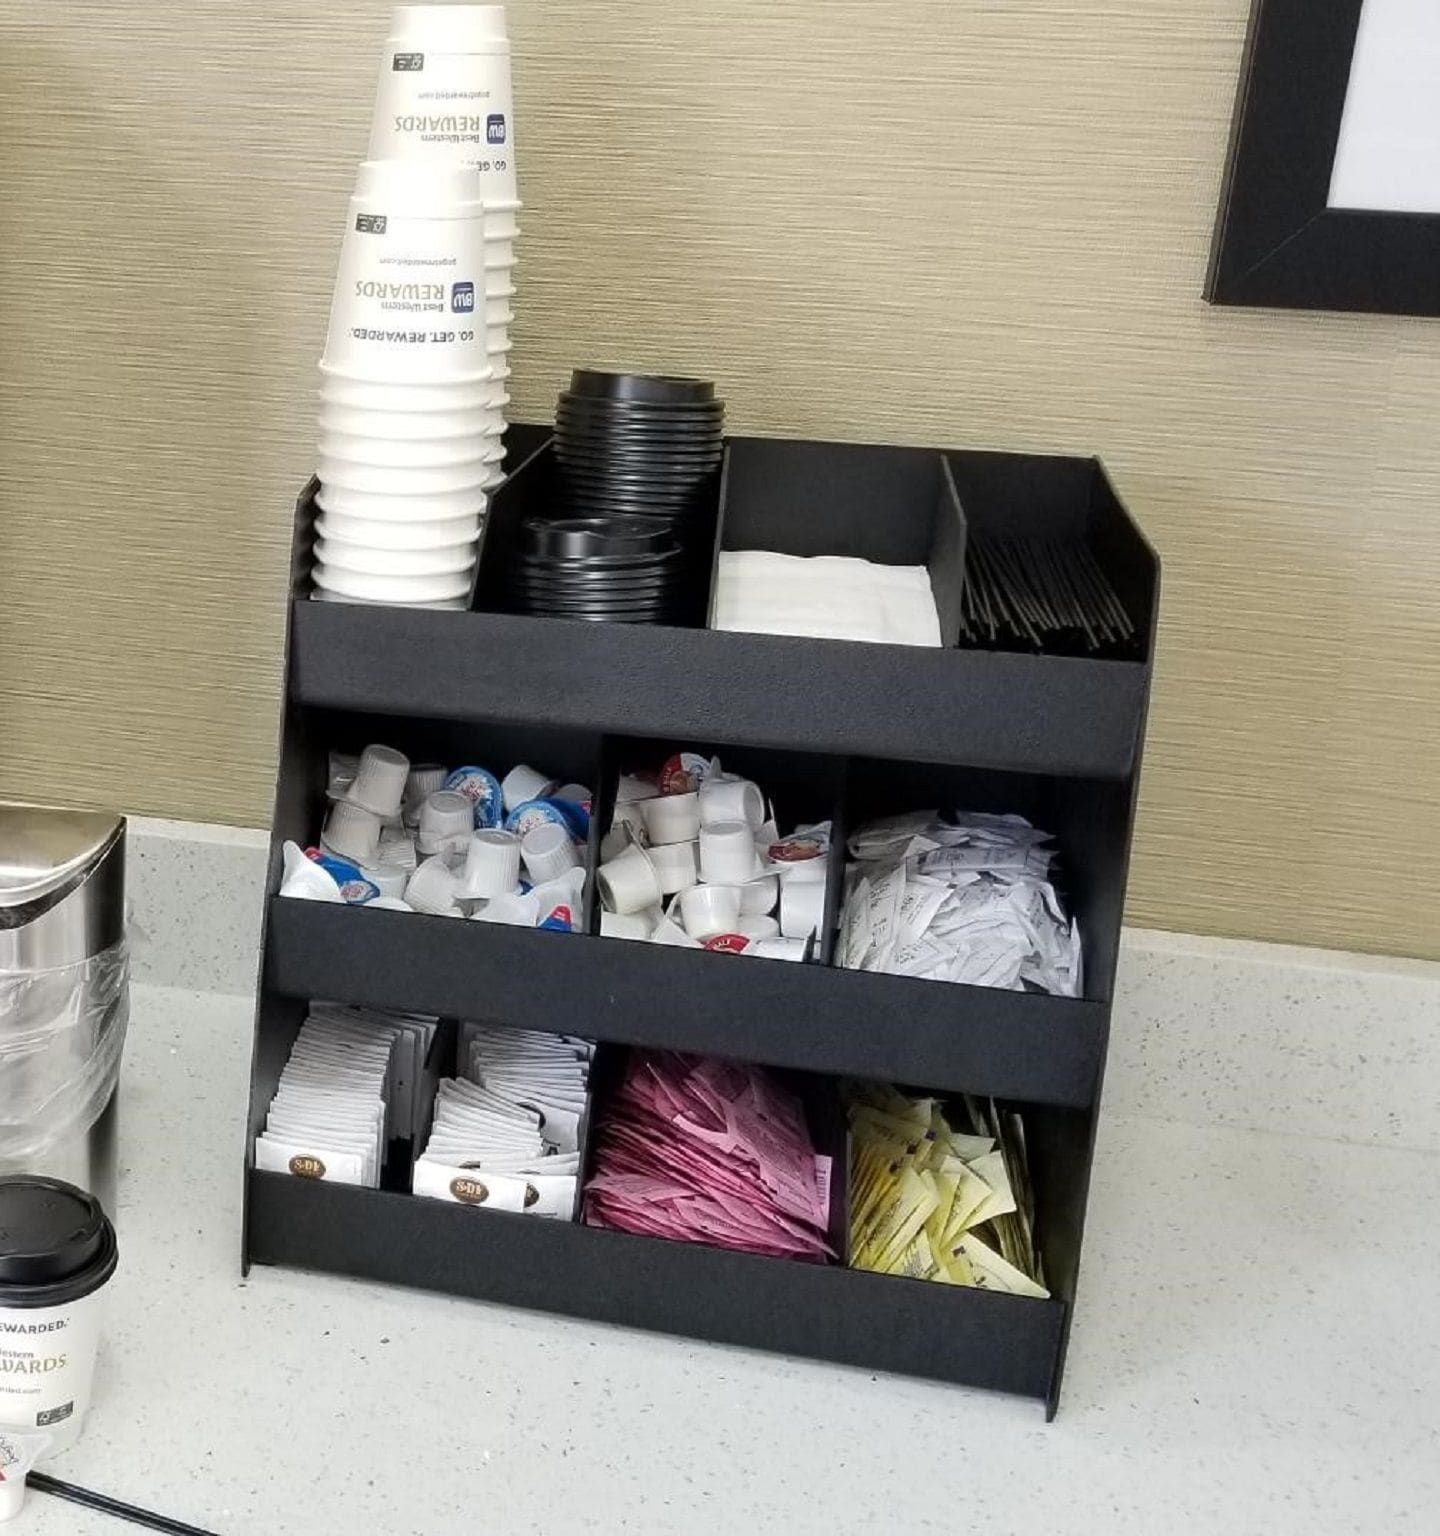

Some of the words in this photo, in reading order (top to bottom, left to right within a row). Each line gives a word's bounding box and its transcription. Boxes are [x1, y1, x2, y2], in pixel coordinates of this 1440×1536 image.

[394, 115, 480, 132] REWARDS
[489, 124, 504, 139] BW
[421, 134, 459, 144] Western
[461, 134, 480, 143] Best
[355, 280, 444, 300] REWARDS
[454, 292, 473, 307] BW
[381, 301, 421, 312] Western
[423, 302, 444, 312] Best
[429, 331, 455, 343] GET.
